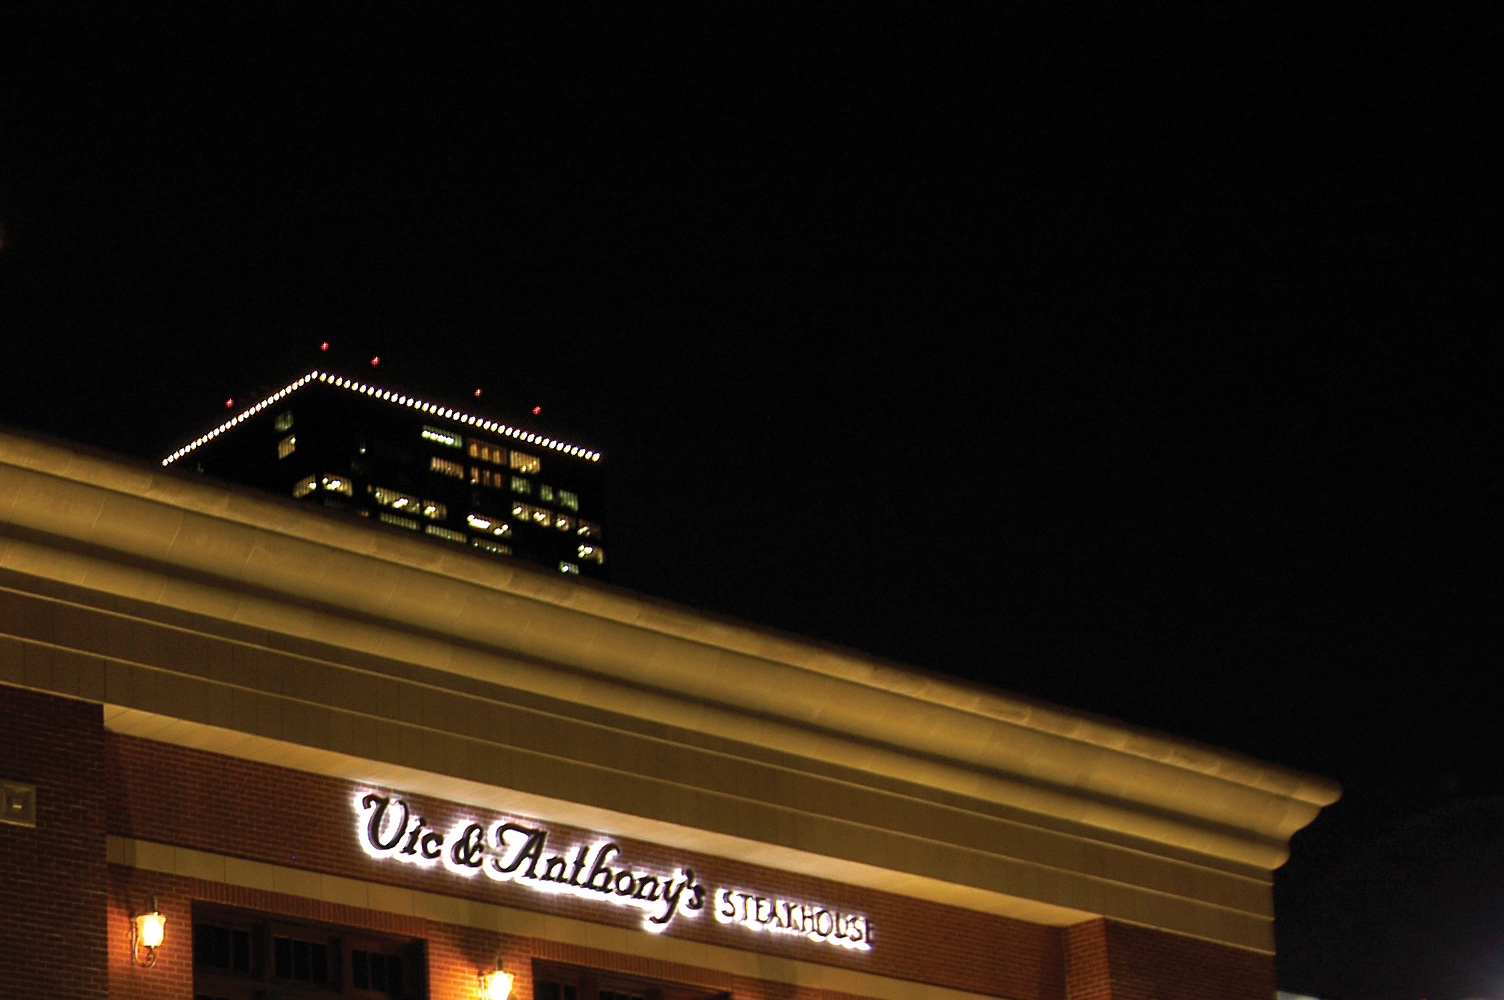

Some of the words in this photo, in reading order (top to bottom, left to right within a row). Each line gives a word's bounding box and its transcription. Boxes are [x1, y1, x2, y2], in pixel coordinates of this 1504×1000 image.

[362, 793, 444, 859] Vic
[450, 823, 485, 868] &
[490, 822, 706, 924] Anthony's
[721, 890, 875, 944] STEAKHOUSE
